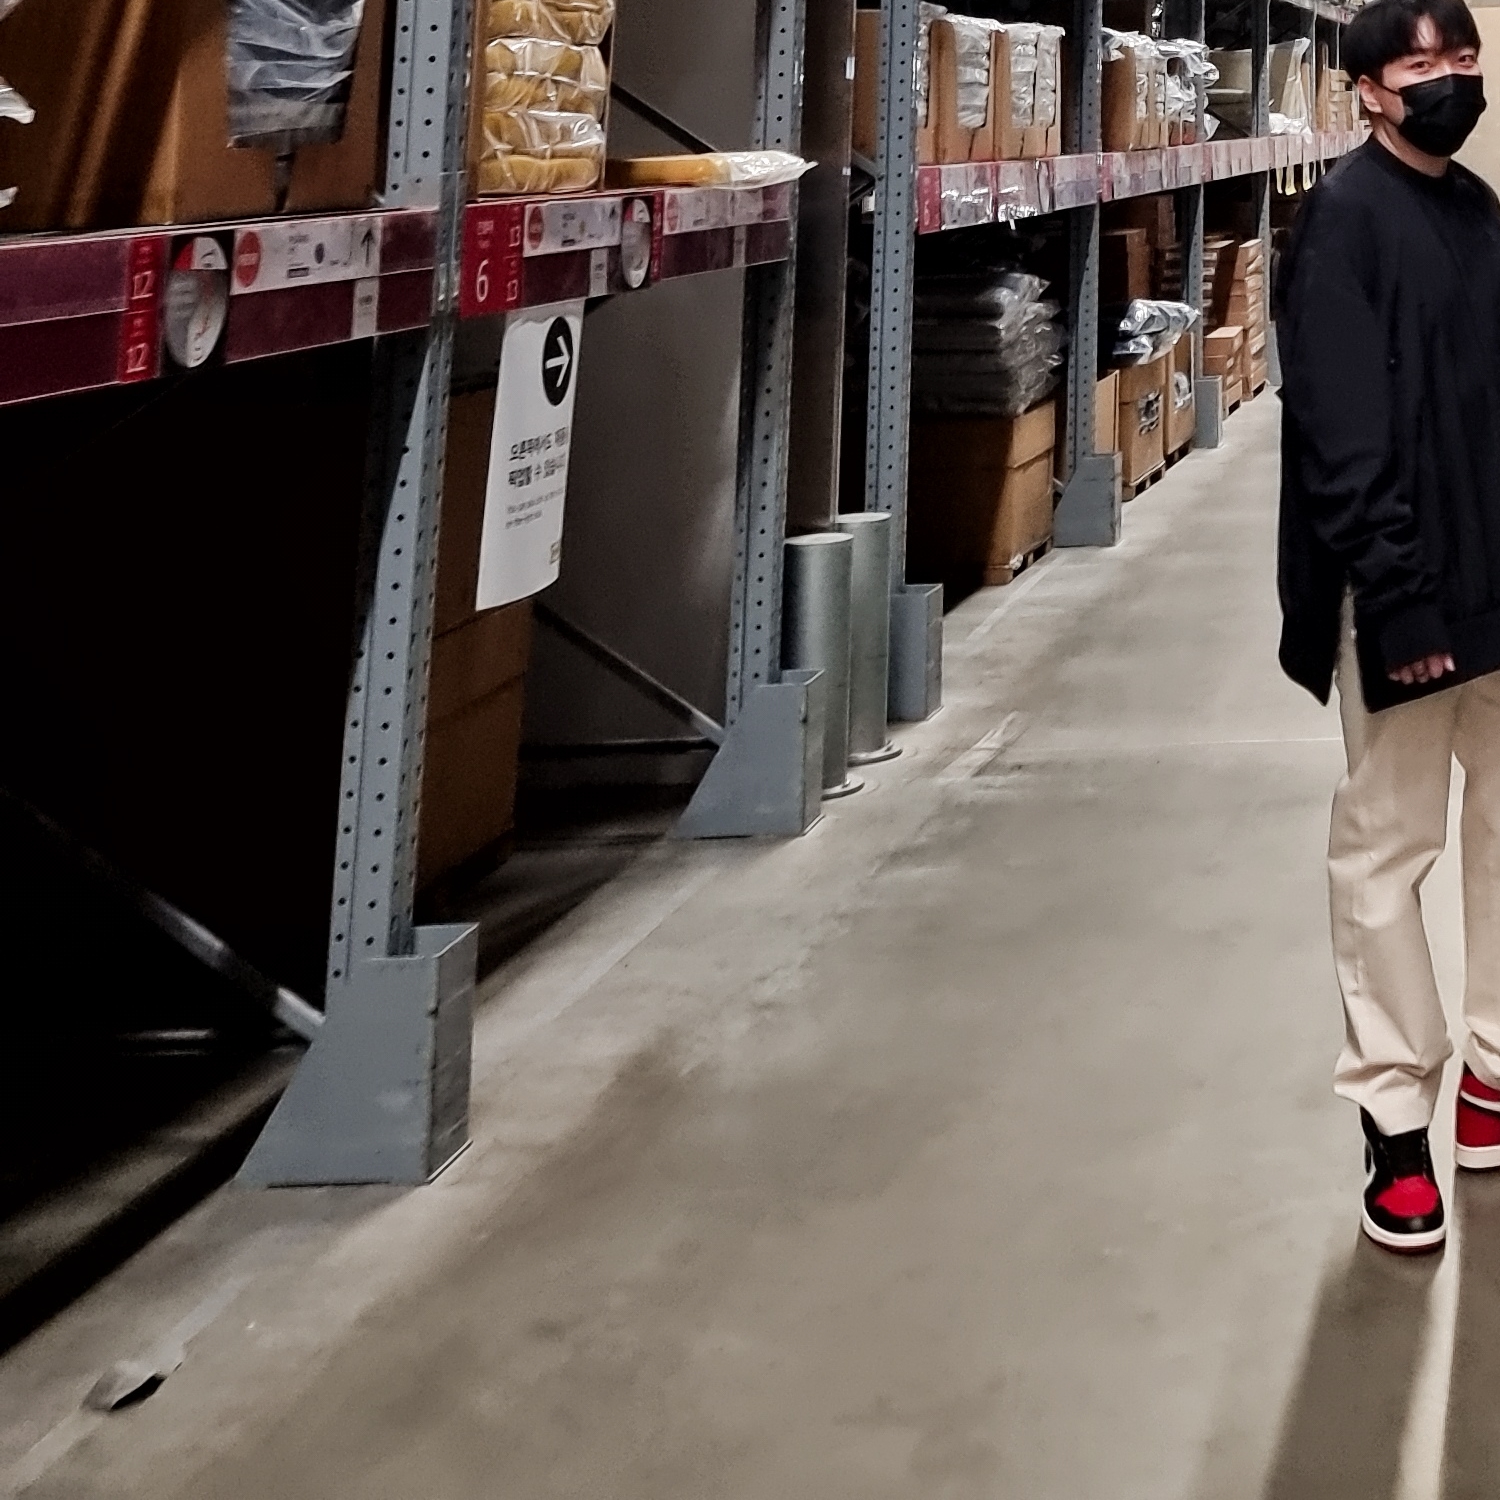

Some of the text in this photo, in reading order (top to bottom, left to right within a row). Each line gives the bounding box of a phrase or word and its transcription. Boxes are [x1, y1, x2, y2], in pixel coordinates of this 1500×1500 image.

[131, 271, 153, 300] 12
[476, 259, 489, 303] 6
[126, 342, 148, 373] 12
